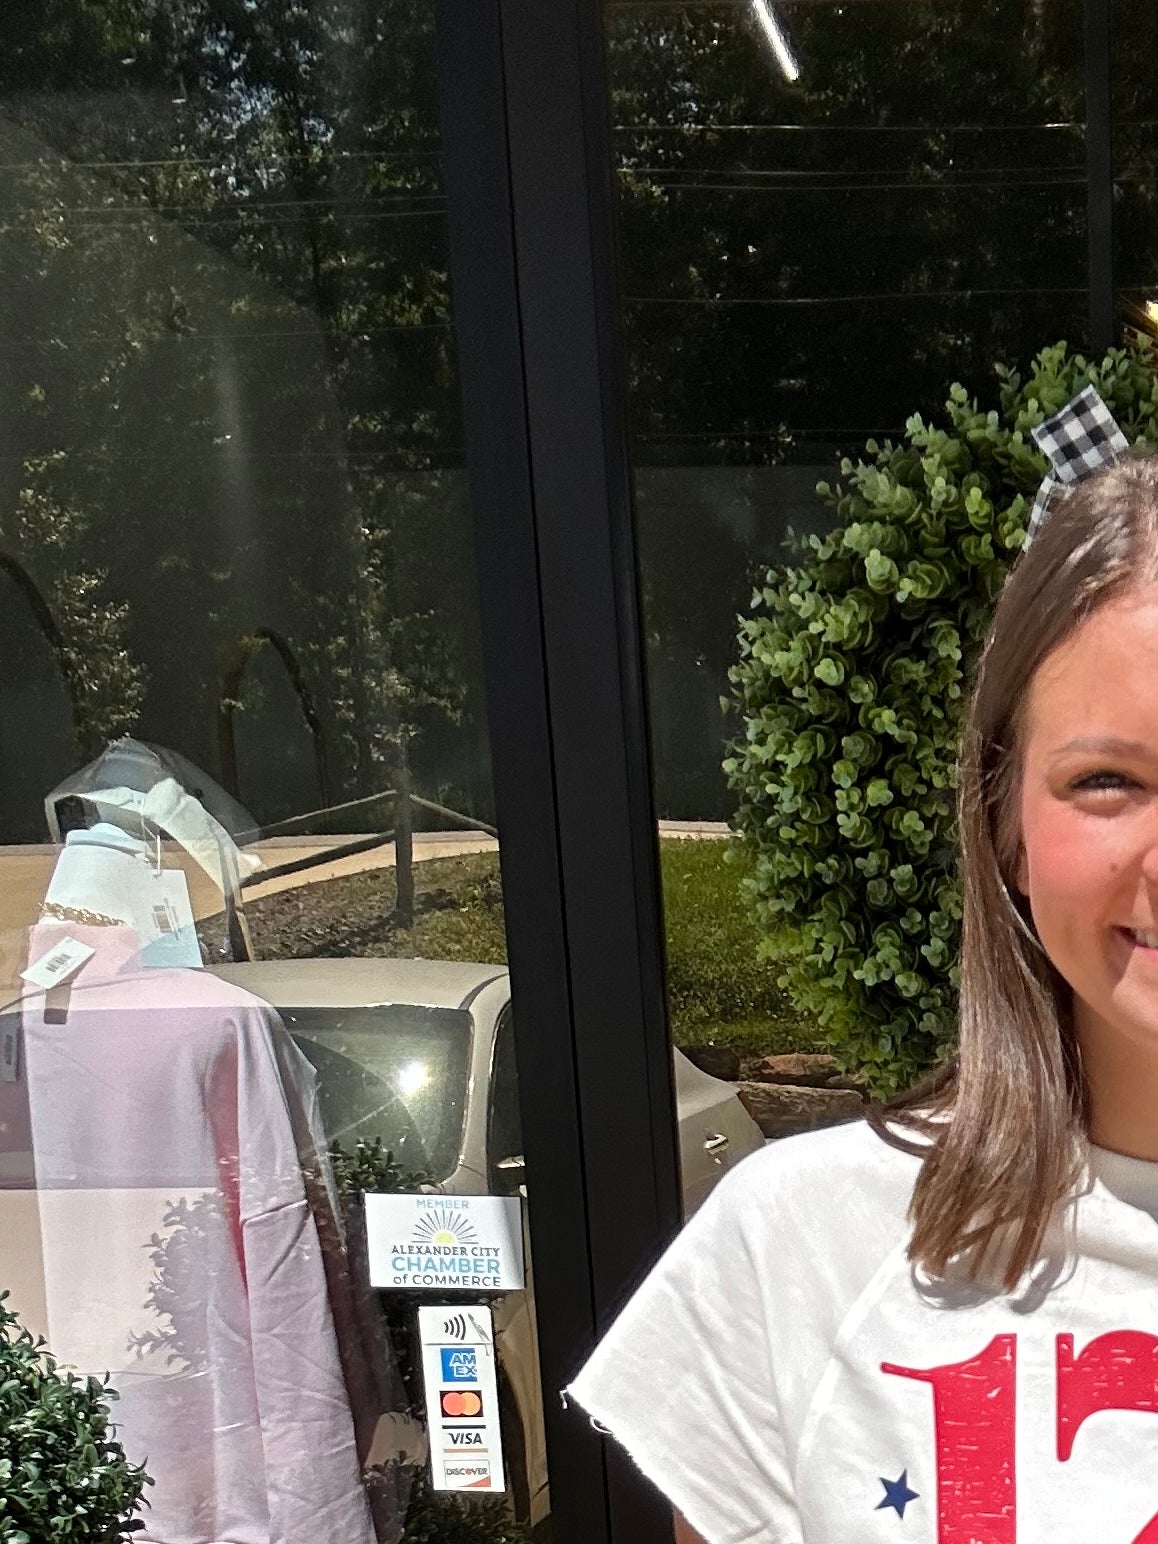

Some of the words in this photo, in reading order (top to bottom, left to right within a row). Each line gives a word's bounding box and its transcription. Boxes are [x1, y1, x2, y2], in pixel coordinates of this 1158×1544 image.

[416, 1198, 470, 1209] MEMBER
[391, 1244, 469, 1257] ALEXANDER
[471, 1246, 500, 1257] CITY
[391, 1256, 501, 1274] CHAMBER
[393, 1273, 409, 1286] of
[412, 1274, 501, 1287] COMMERCE
[450, 1352, 477, 1366] AM
[453, 1365, 477, 1377] EX
[447, 1432, 483, 1445] VISA
[445, 1467, 488, 1476] DISCOVER
